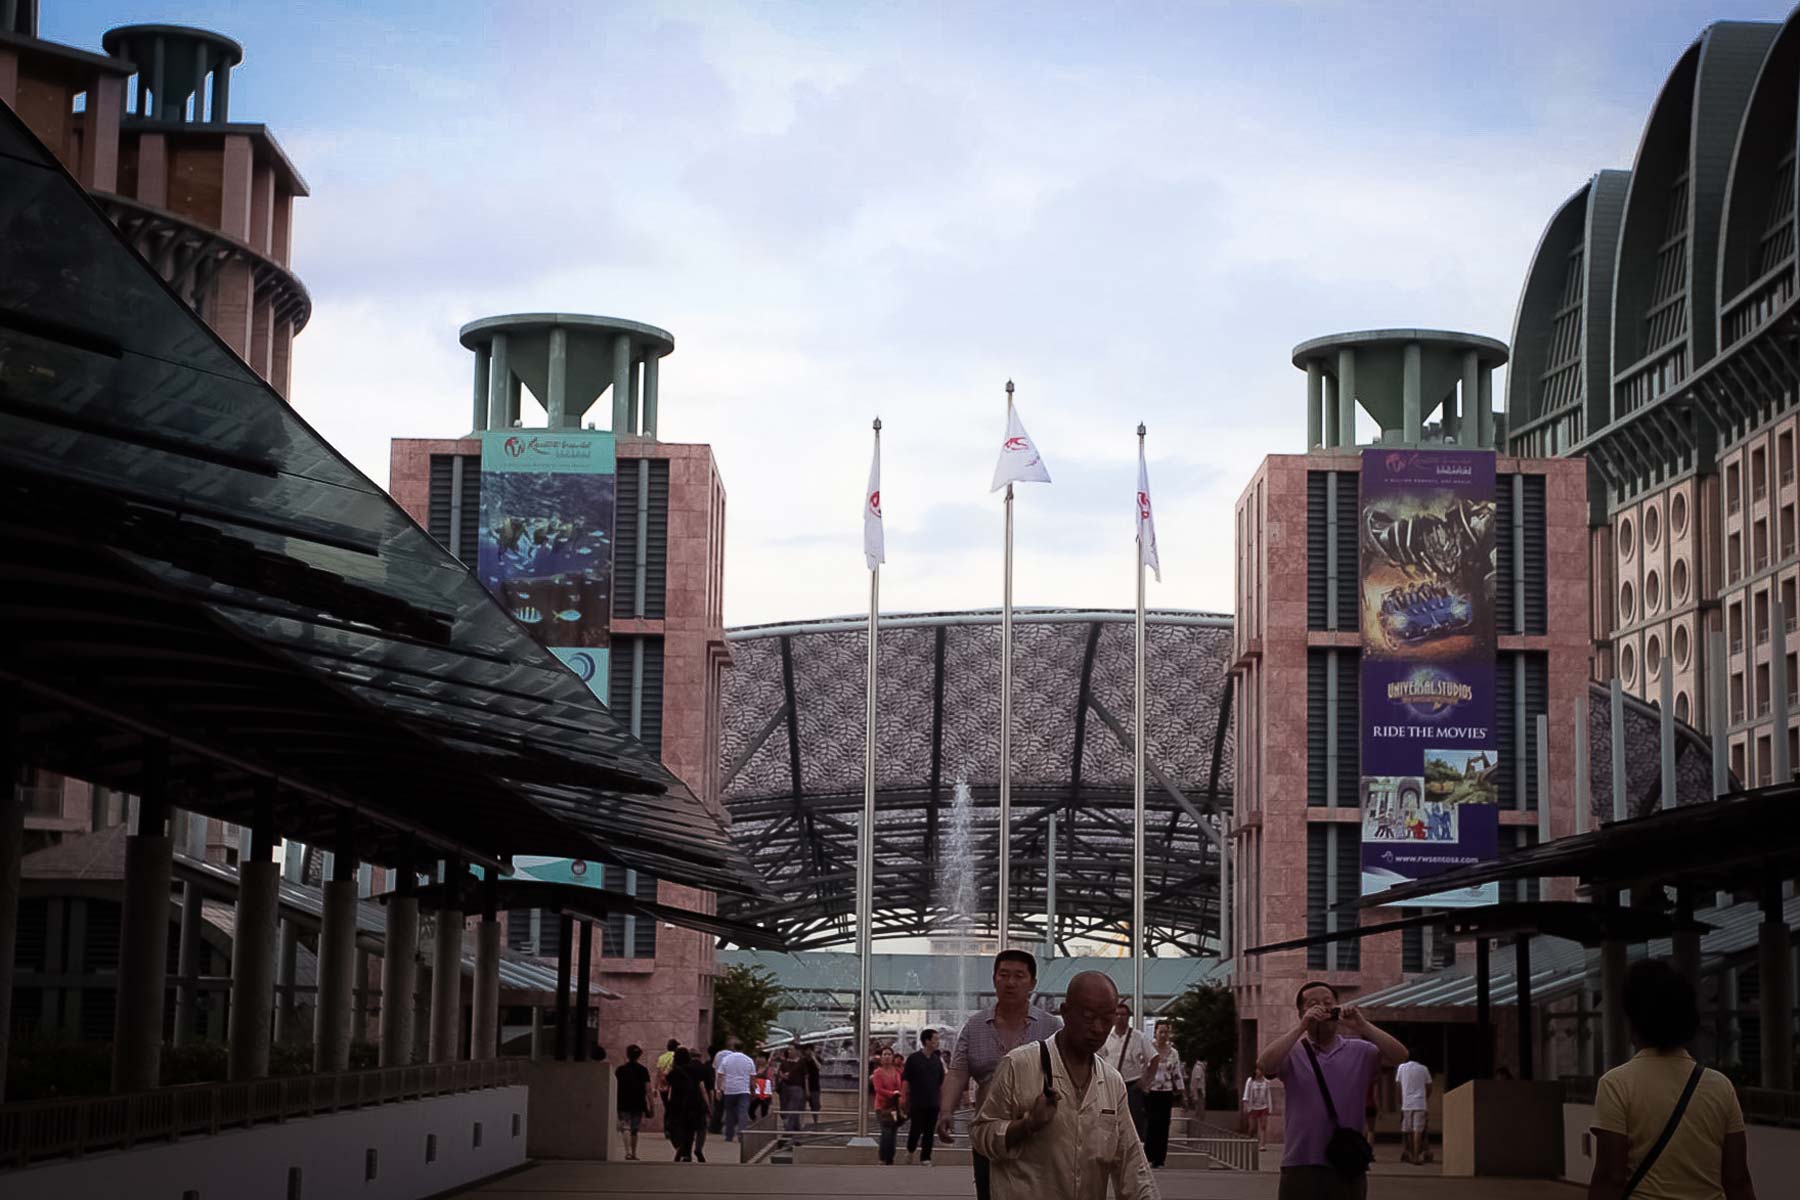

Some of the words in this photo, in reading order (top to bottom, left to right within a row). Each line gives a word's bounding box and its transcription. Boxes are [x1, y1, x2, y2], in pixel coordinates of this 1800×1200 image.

[1387, 680, 1435, 698] UNIVERSAL
[1437, 680, 1473, 701] STUDIOS
[1373, 726, 1405, 737] RIDE
[1407, 726, 1434, 737] THE
[1436, 727, 1487, 739] MOVIES
[1395, 855, 1479, 864] www.rwsentosa.com
